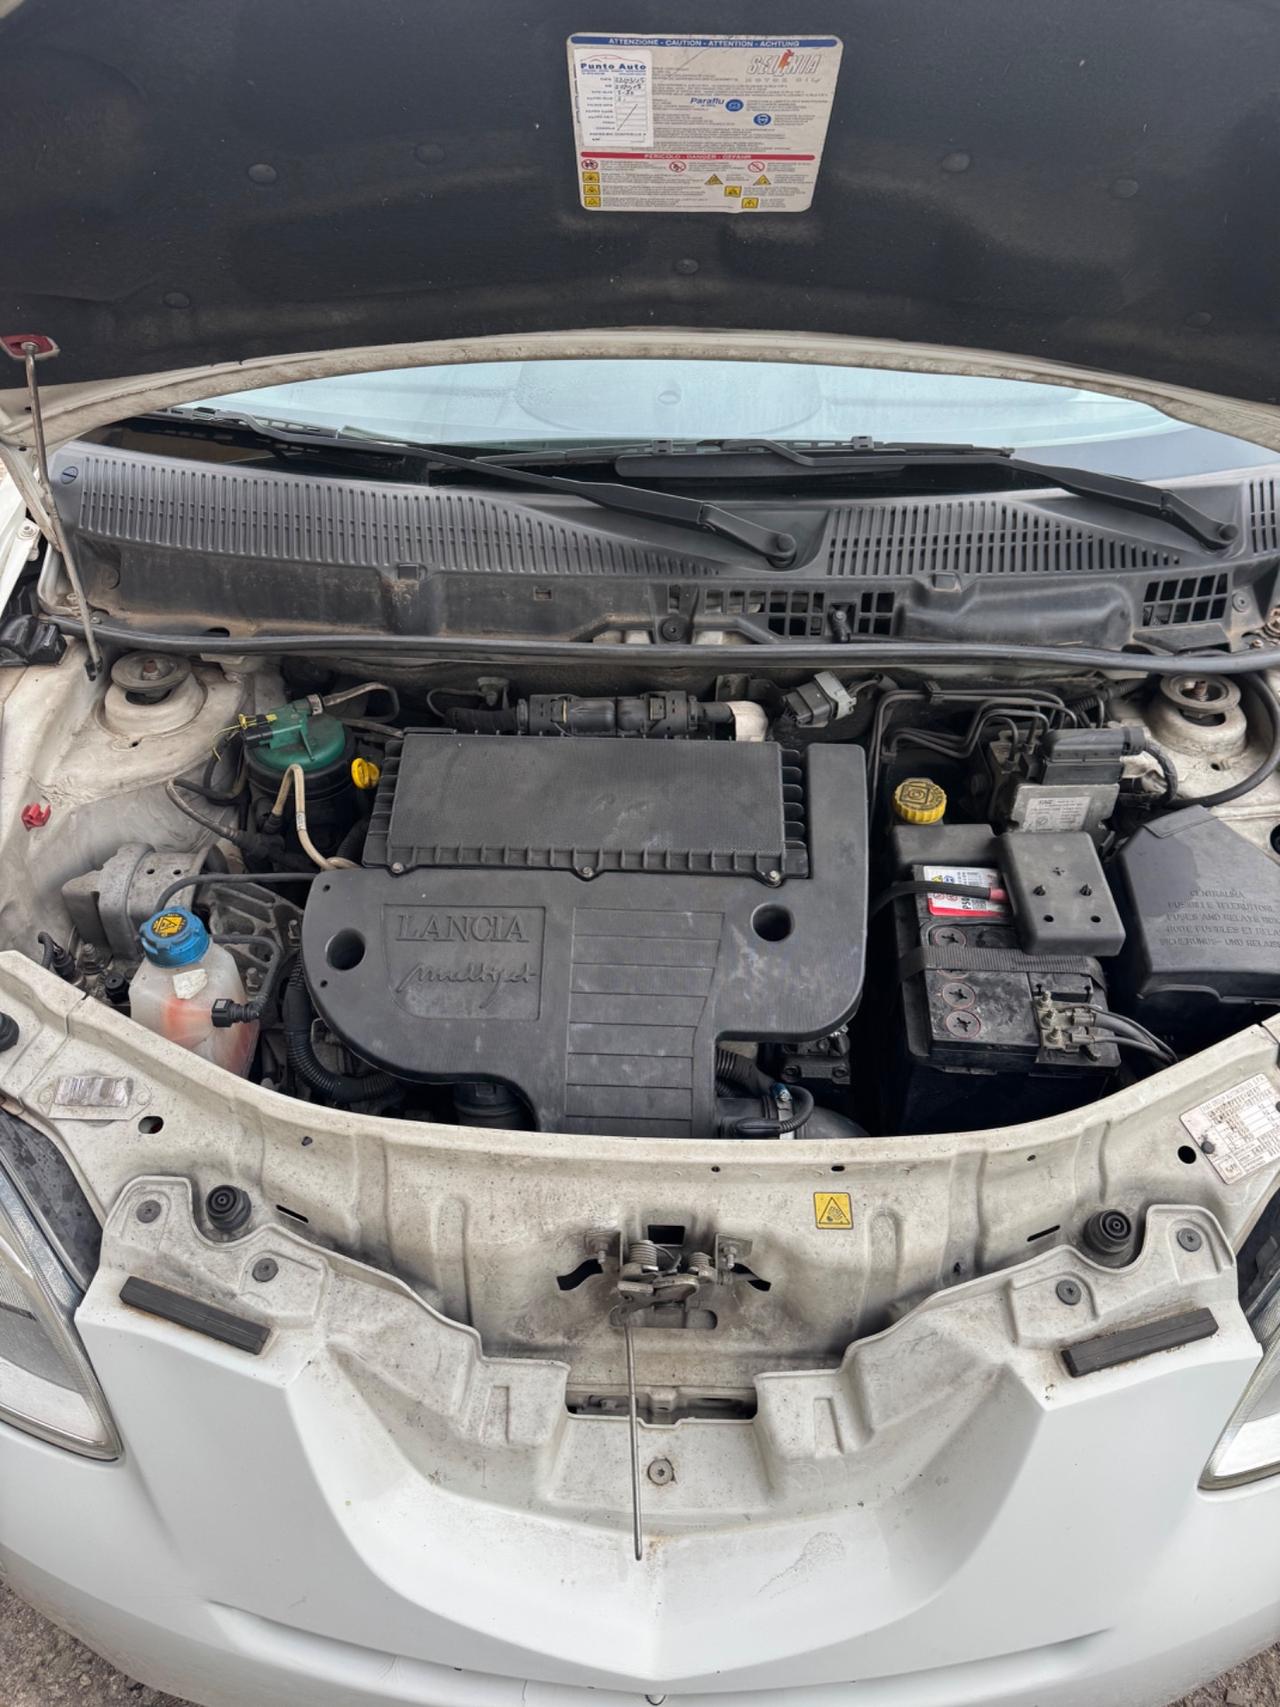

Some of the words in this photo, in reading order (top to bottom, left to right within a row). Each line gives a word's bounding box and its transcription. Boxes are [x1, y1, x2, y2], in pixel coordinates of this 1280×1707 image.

[608, 38, 659, 46] ATTENZIONE
[665, 39, 701, 47] CAUTION
[708, 40, 753, 48] ATTENTION
[690, 97, 725, 105] Paraflu
[396, 914, 530, 943] LANCIA
